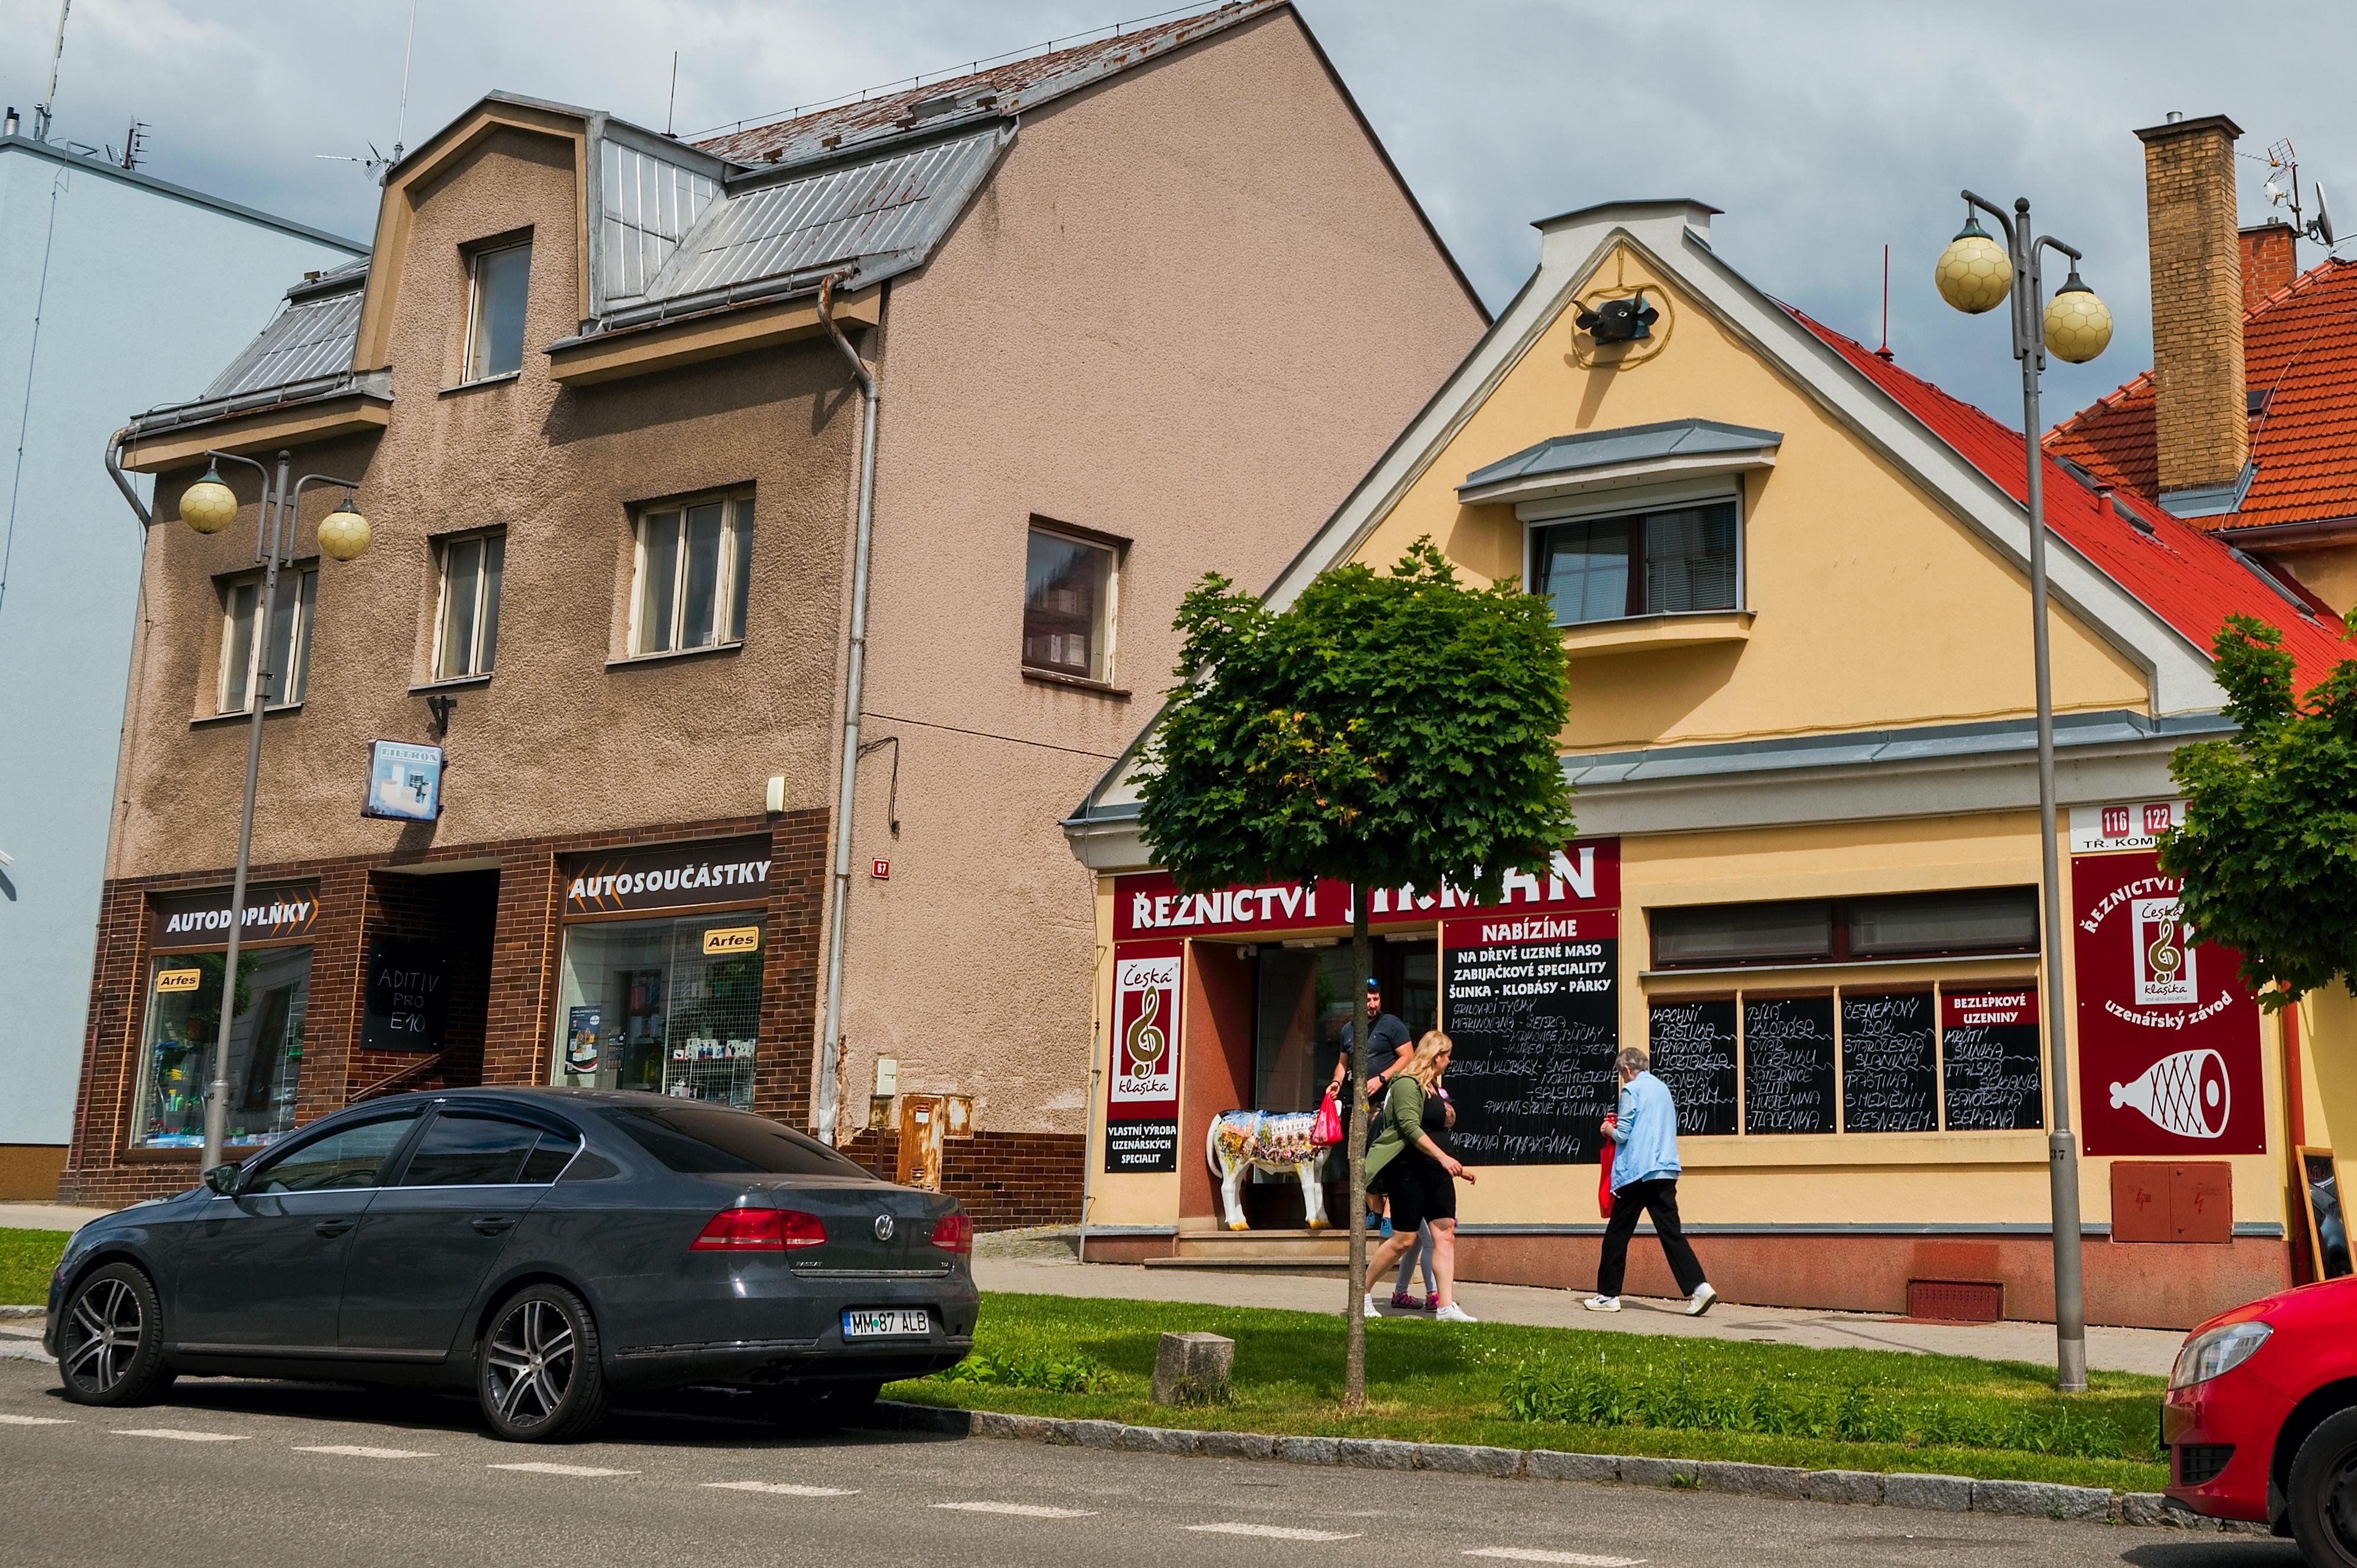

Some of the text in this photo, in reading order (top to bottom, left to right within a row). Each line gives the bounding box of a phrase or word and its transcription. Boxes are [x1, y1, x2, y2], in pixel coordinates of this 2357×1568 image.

[2105, 809, 2169, 832] 116 122
[2083, 838, 2109, 848] TŘ.
[878, 863, 886, 874] 67
[569, 860, 771, 899] AUTOSOUČÁSTKY
[166, 902, 310, 933] AUTODPLŇKY
[1482, 916, 1577, 942] NABÍZÍME
[708, 935, 754, 947] Arfes
[1458, 944, 1601, 963] NA DŘEVĚ UZENÉ MASO
[1124, 964, 1173, 987] Česká
[1453, 961, 1607, 981] ZABIJAČKOVÉ SPECIALITY
[161, 976, 196, 986] Arfes
[378, 968, 439, 992] ADITIV
[1449, 984, 1491, 999] ŠUNKA
[1503, 980, 1558, 996] KLOBÁSY
[1569, 977, 1611, 993] PÁRKY
[2145, 984, 2187, 996] klasika
[394, 993, 423, 1008] PRO
[1844, 997, 1919, 1019] ČESNEKOVÝ
[1954, 993, 2026, 1009] BEZLEPKOVÉ
[1963, 1012, 2018, 1024] UZENINY
[2105, 990, 2233, 1031] uzenářský závod
[391, 1012, 425, 1032] E10
[1861, 1019, 1895, 1034] BOK
[1750, 1039, 1786, 1052] OVAR
[1856, 1052, 1918, 1067] SLANINA
[1119, 1078, 1168, 1095] klasika
[1851, 1109, 1931, 1131] ČESNEKEM
[1108, 1123, 1177, 1136] VLASTNÍ VÝROBA
[1112, 1135, 1171, 1150] UZENÁŘSKÝCH
[1121, 1154, 1161, 1164] SPECIALIT
[852, 1312, 927, 1334] MM 87 ALB
